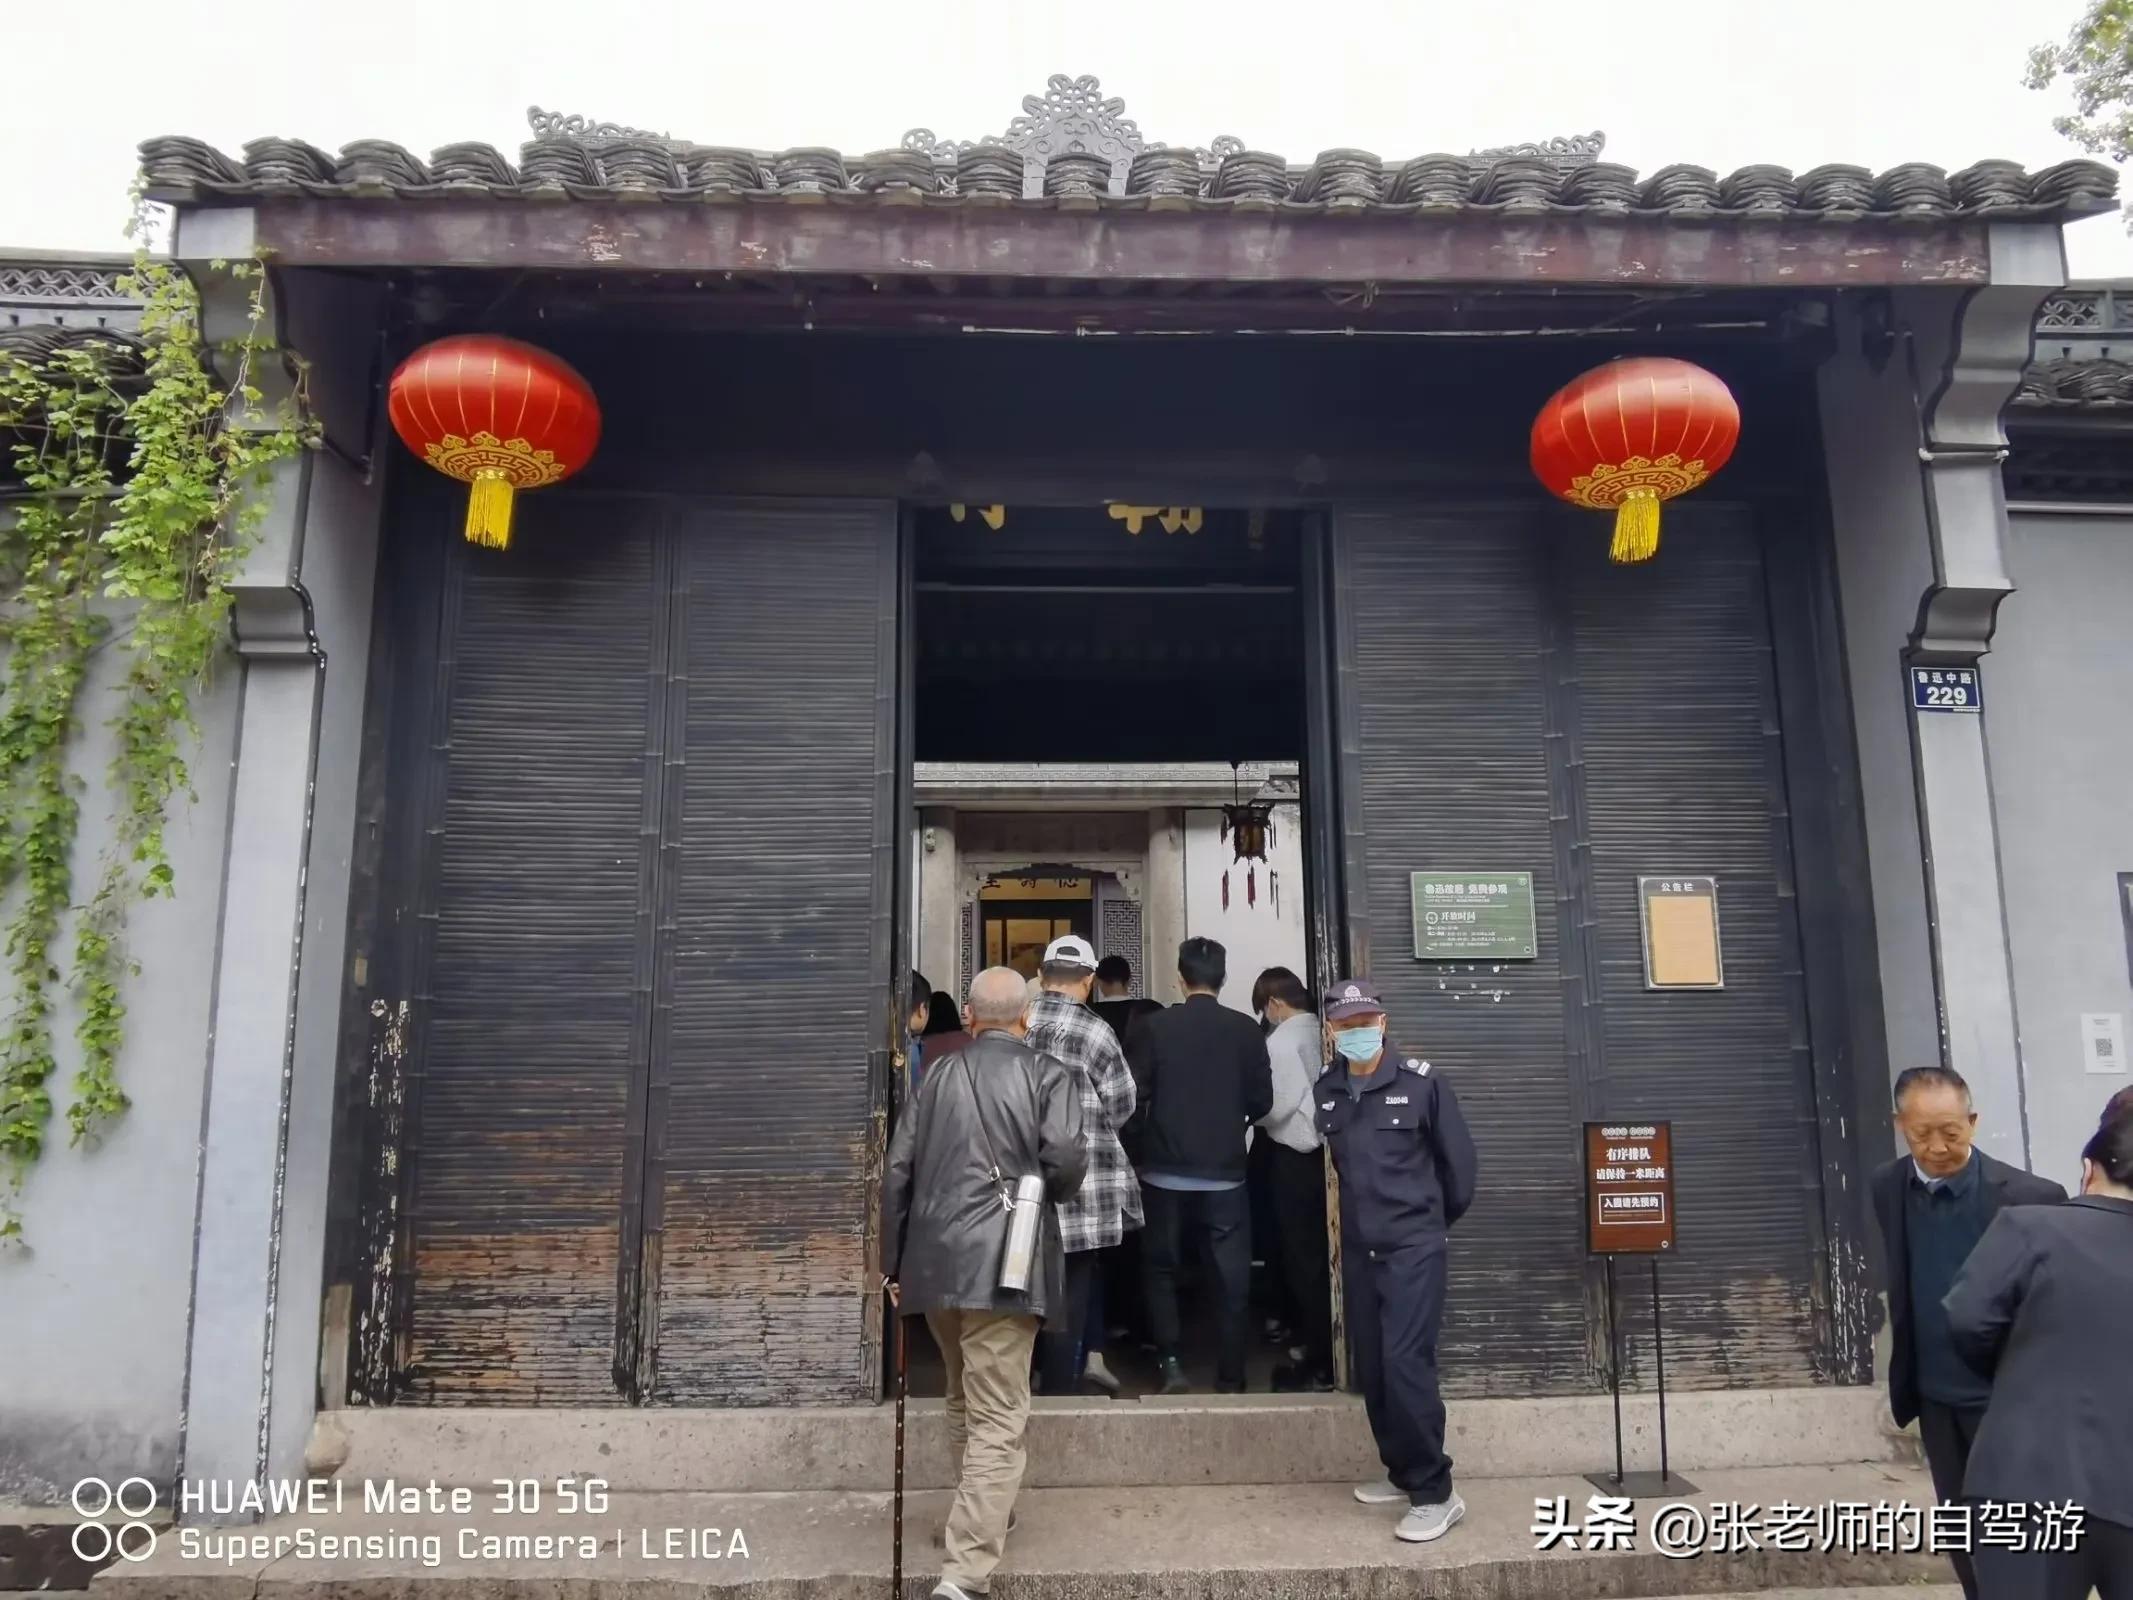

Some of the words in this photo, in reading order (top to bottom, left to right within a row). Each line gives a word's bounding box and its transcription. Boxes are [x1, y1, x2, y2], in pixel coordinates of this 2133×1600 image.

[1917, 671, 1972, 684] 鲁迅中路
[1926, 686, 1968, 705] 229
[1661, 882, 1695, 892] 公告栏
[1606, 1147, 1652, 1162] 有序排队
[1596, 1166, 1666, 1180] 请保持一米距离
